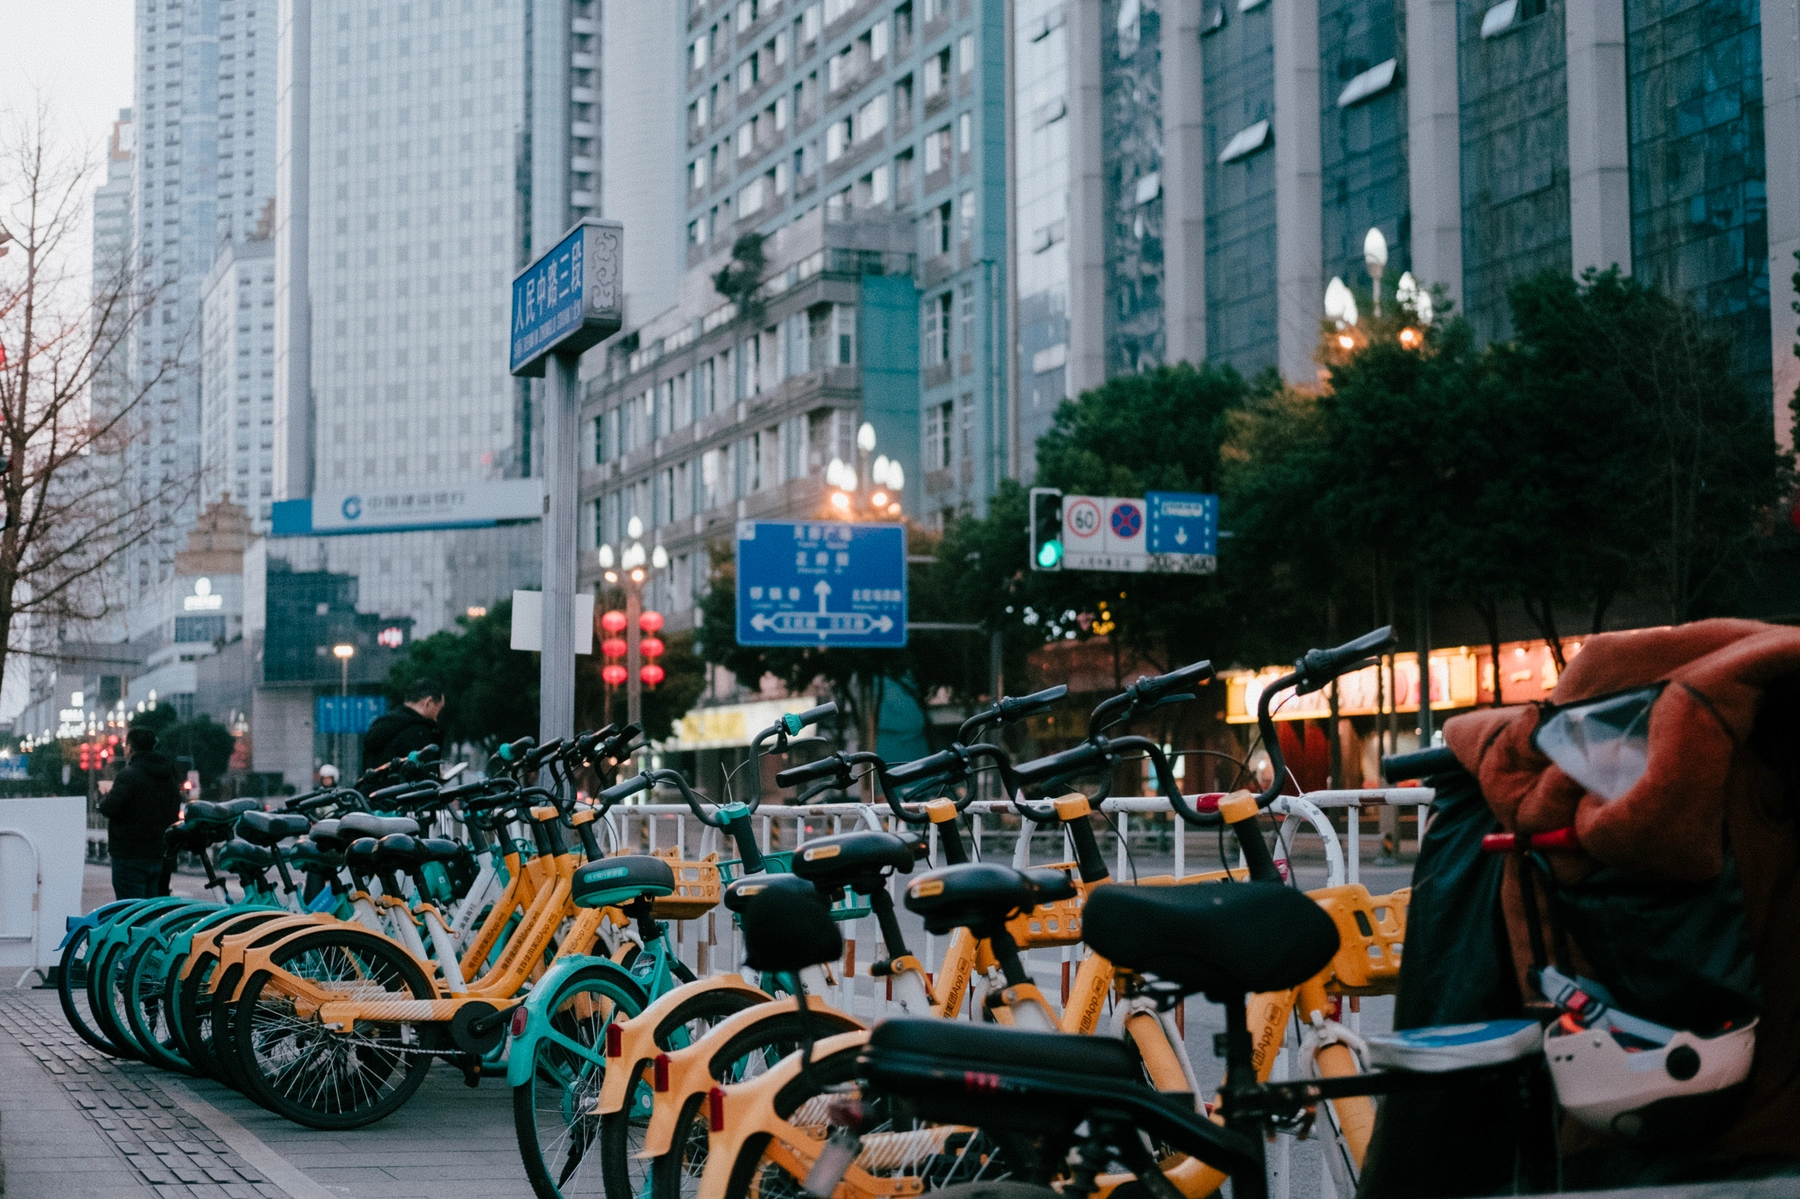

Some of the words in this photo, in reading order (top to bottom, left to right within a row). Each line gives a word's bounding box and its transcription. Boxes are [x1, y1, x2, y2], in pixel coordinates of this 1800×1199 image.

[514, 240, 582, 334] 人民中路三段
[1075, 509, 1094, 529] 60
